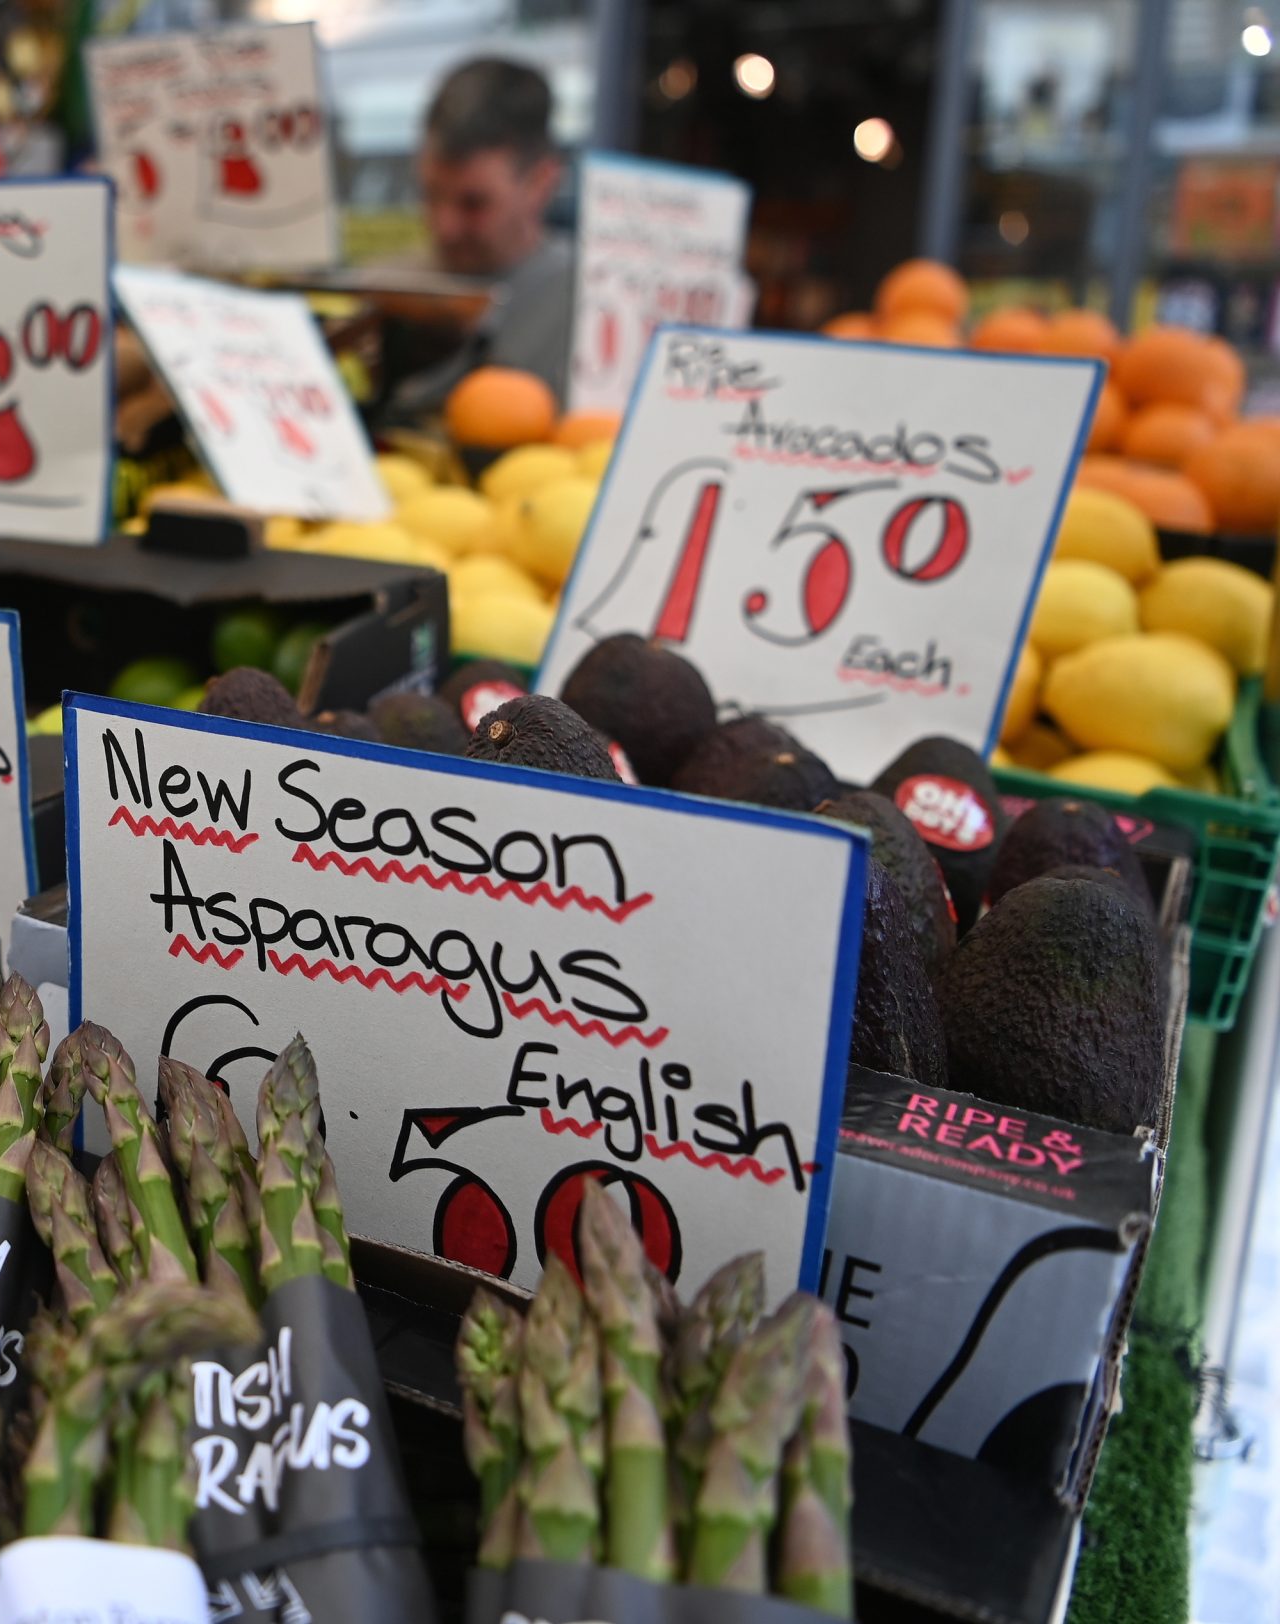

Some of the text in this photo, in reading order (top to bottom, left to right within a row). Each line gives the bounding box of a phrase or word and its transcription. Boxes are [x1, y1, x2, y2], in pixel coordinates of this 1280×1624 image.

[665, 337, 782, 395] Ripe
[721, 398, 1001, 485] Avocados
[841, 634, 953, 687] Each
[102, 728, 627, 903] New Season
[151, 840, 648, 1038] Asparagus
[506, 1041, 806, 1191] English
[897, 1112, 1084, 1177] READY
[907, 1093, 1083, 1156] RIPE &
